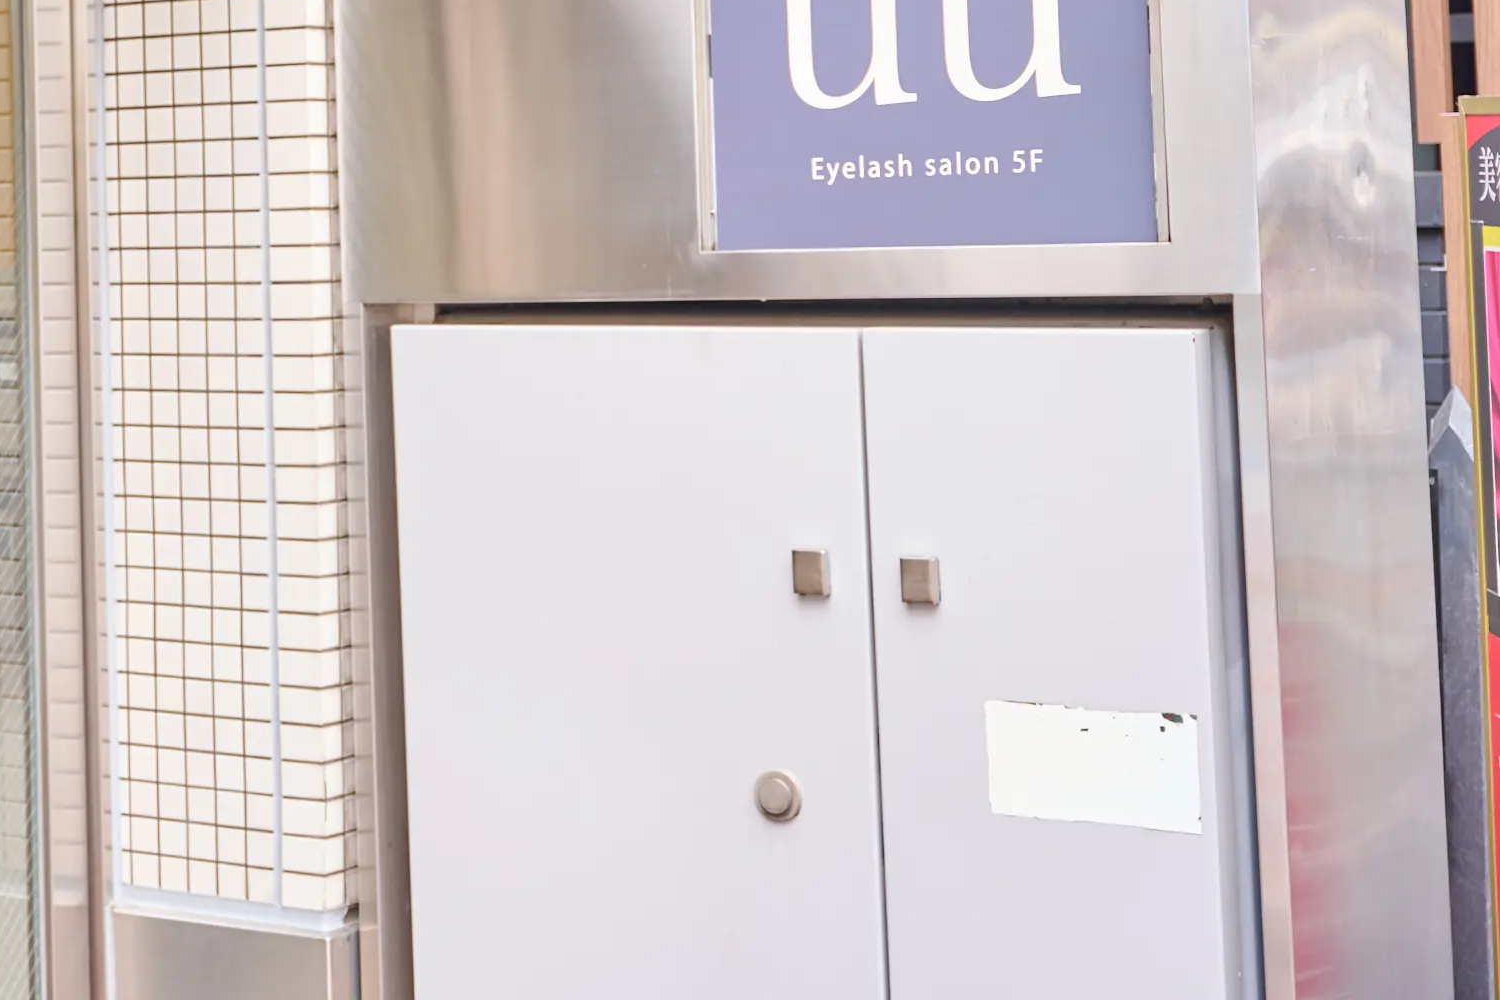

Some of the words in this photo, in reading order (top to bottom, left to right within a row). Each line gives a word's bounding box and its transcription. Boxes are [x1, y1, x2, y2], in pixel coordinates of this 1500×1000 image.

[810, 153, 913, 186] Eyelash
[924, 151, 1000, 178] salon
[1011, 149, 1044, 174] 5F
